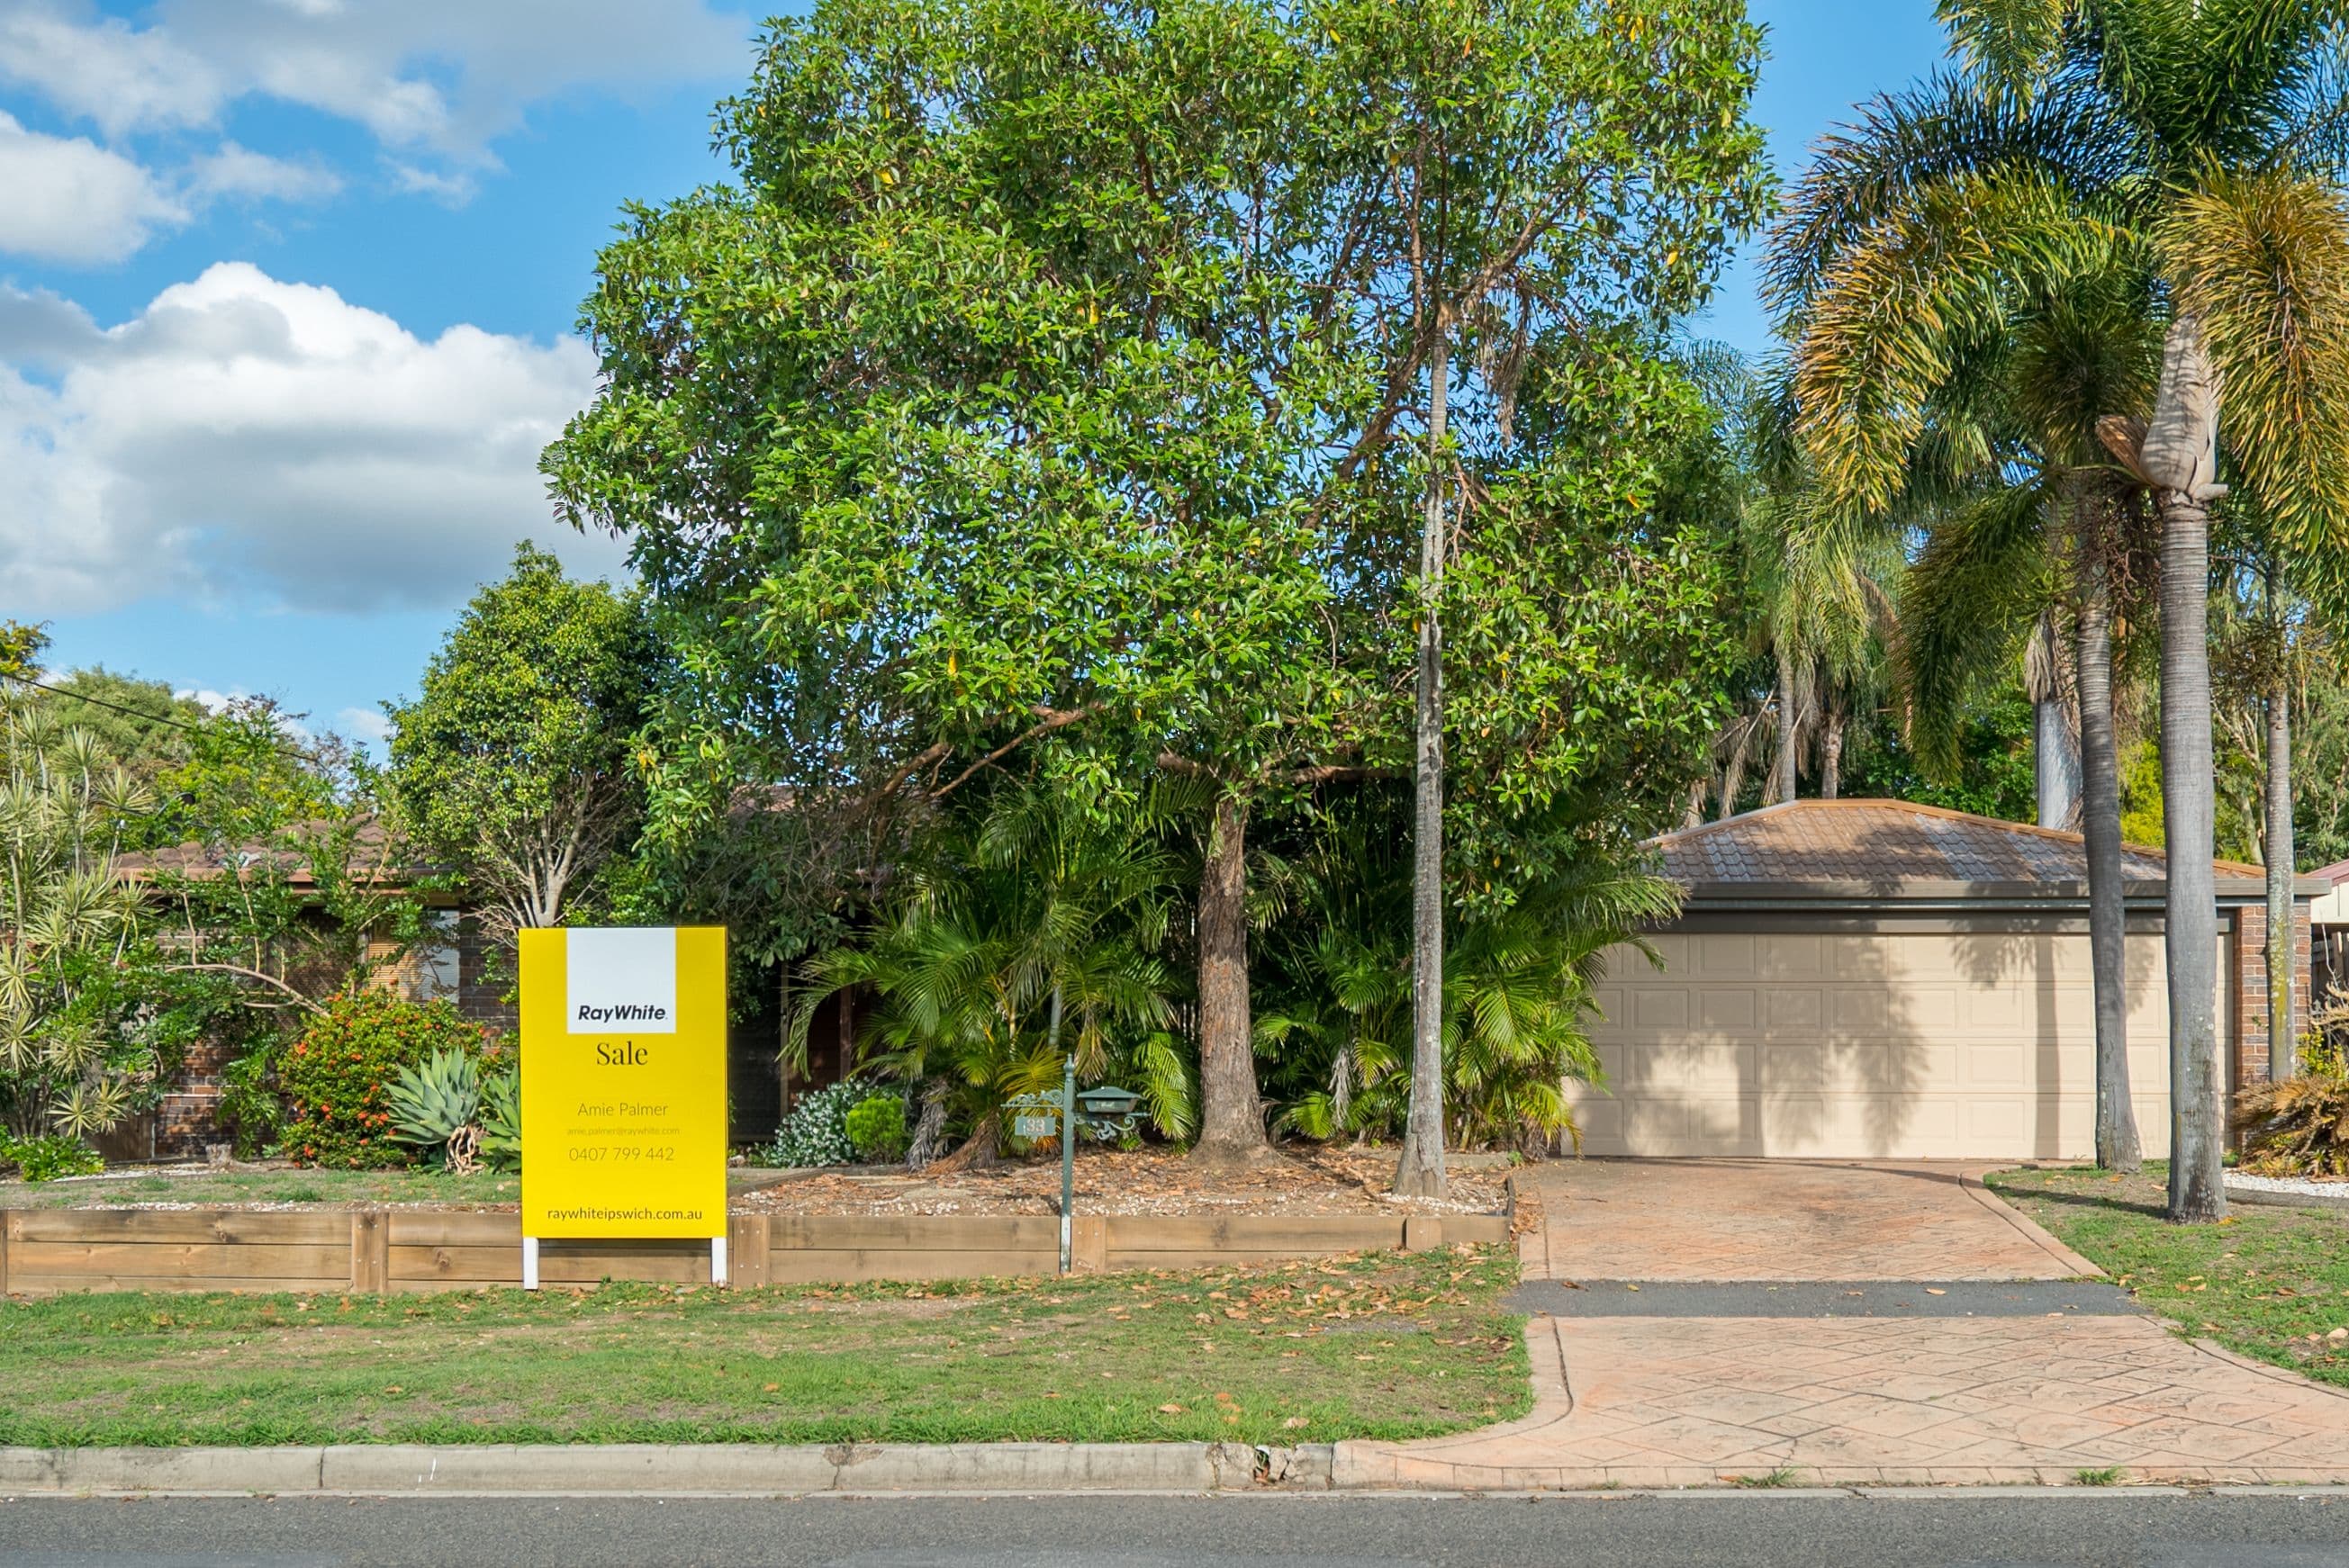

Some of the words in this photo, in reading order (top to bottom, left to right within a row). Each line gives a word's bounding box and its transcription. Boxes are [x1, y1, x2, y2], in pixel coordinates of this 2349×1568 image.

[596, 1041, 648, 1066] Sale
[577, 1103, 614, 1116] Amie
[619, 1103, 668, 1116] Palmer
[569, 1148, 607, 1161] 0407
[613, 1148, 641, 1161] 799
[646, 1148, 674, 1161] 442
[547, 1207, 702, 1221] raywhiteipswich.com.au
